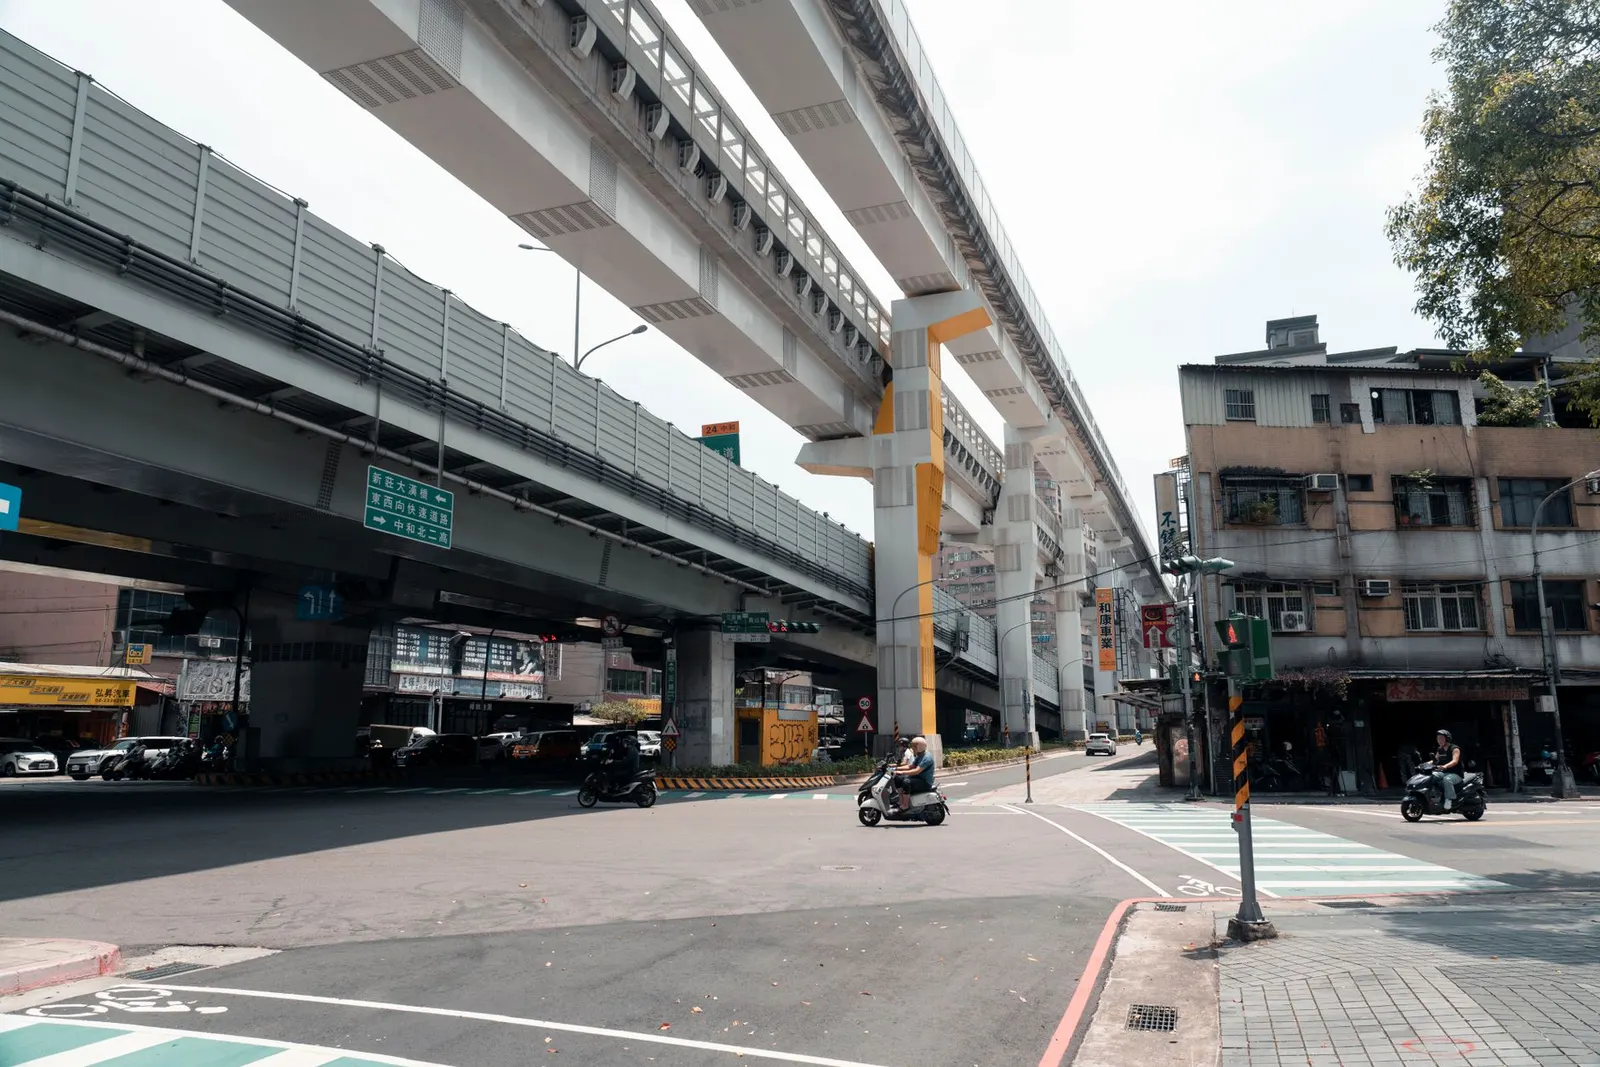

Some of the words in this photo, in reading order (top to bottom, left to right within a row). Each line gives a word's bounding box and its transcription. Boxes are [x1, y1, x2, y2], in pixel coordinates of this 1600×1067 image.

[706, 425, 717, 434] 24
[720, 423, 736, 432] 中和
[371, 492, 449, 526] 東西向快速道路
[393, 518, 449, 545] 中和北二高
[1098, 602, 1113, 649] 和康車業
